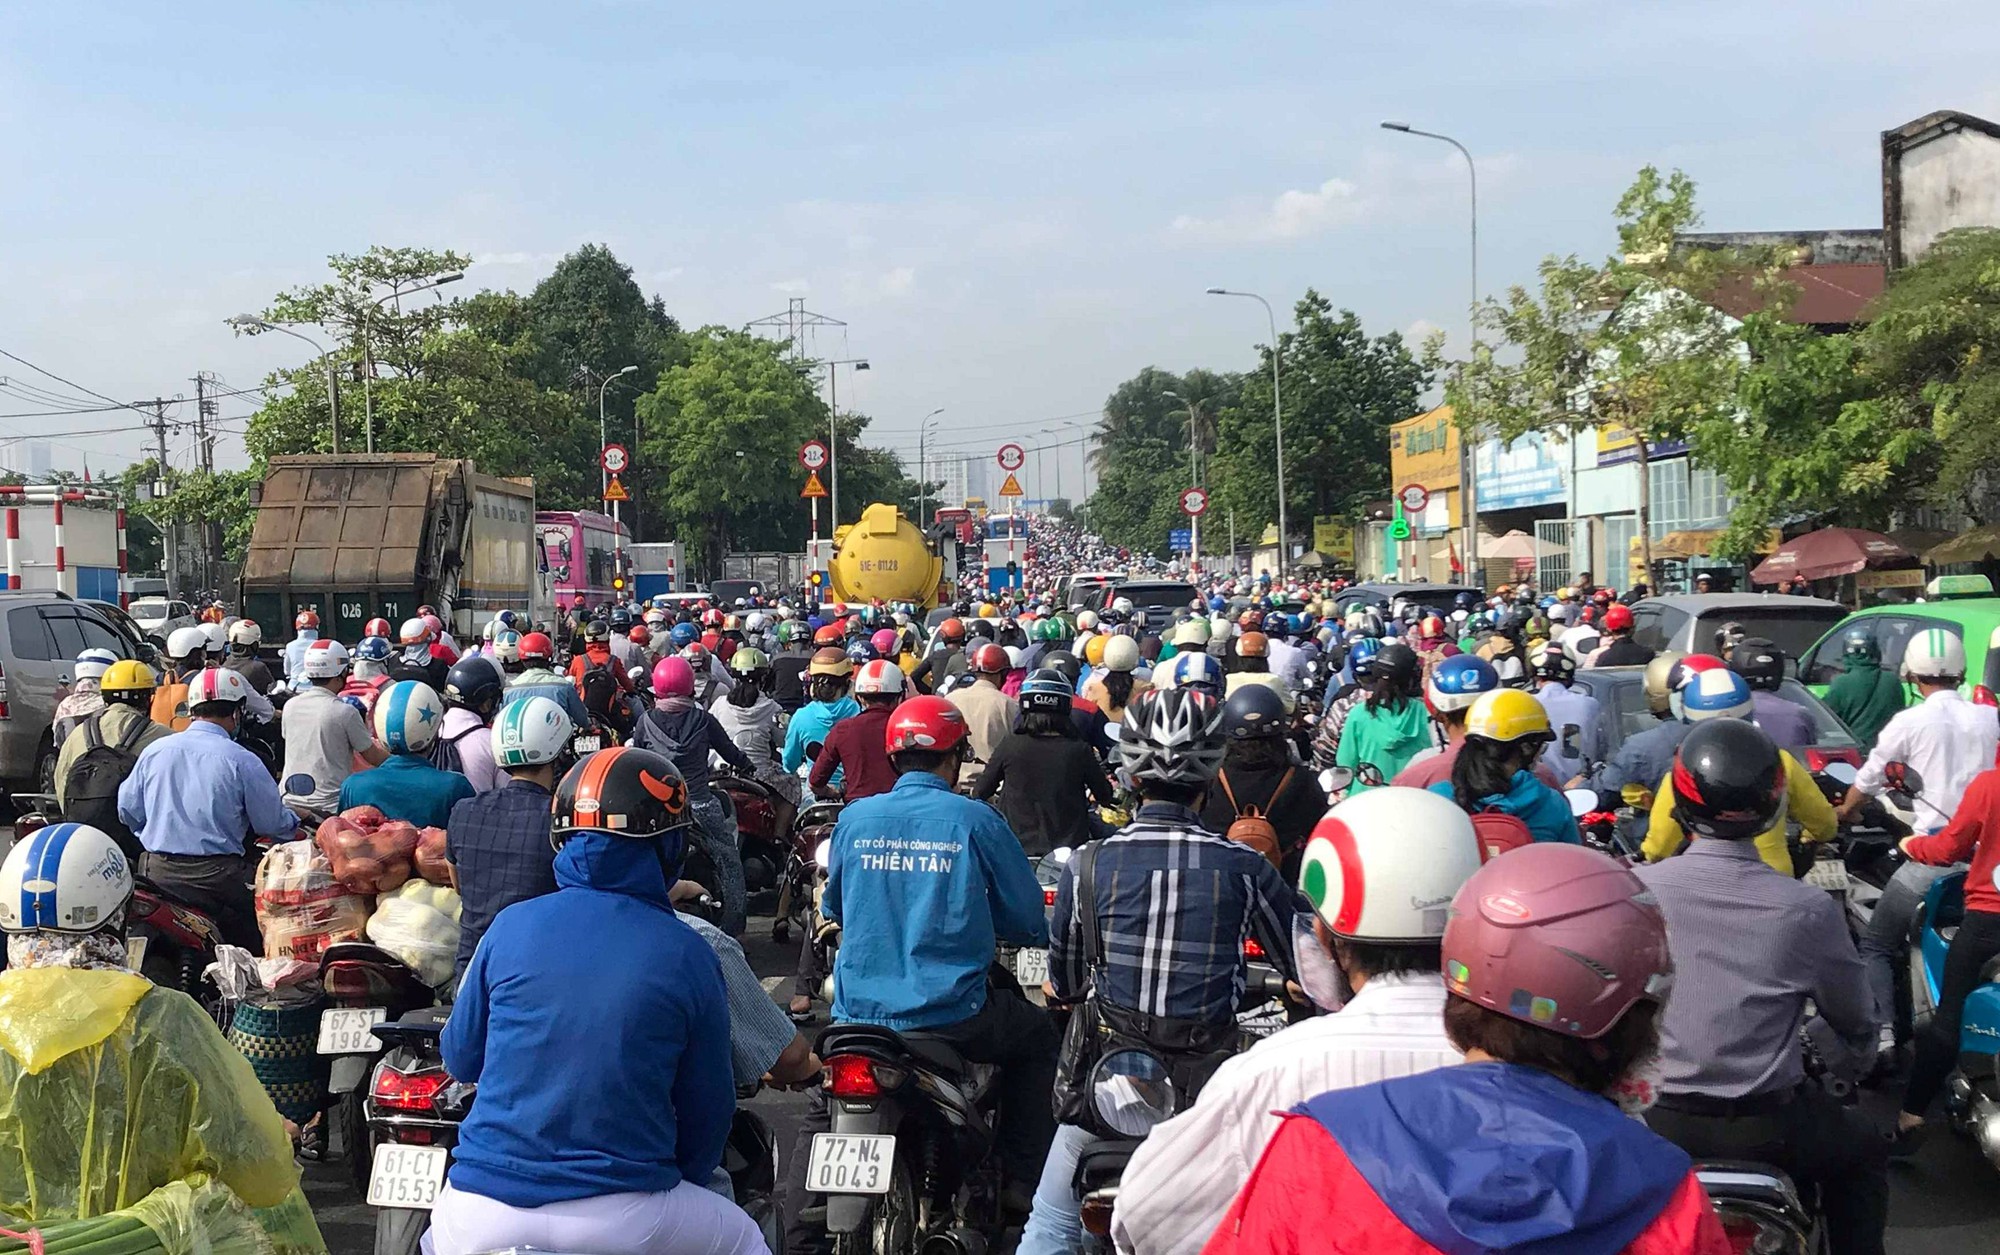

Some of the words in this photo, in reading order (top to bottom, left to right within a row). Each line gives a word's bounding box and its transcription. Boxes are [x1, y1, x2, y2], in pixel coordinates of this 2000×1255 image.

[341, 603, 362, 618] 026
[385, 602, 398, 618] 71
[854, 839, 871, 849] C.TY
[860, 851, 914, 872] THIÊN
[918, 853, 952, 874] TÂN
[331, 1010, 376, 1030] 67-S1
[330, 1032, 374, 1051] 1982
[824, 1138, 880, 1163] 77-N4
[385, 1150, 434, 1176] 61-C1
[819, 1164, 879, 1188] 0043
[373, 1176, 437, 1204] 615.53
